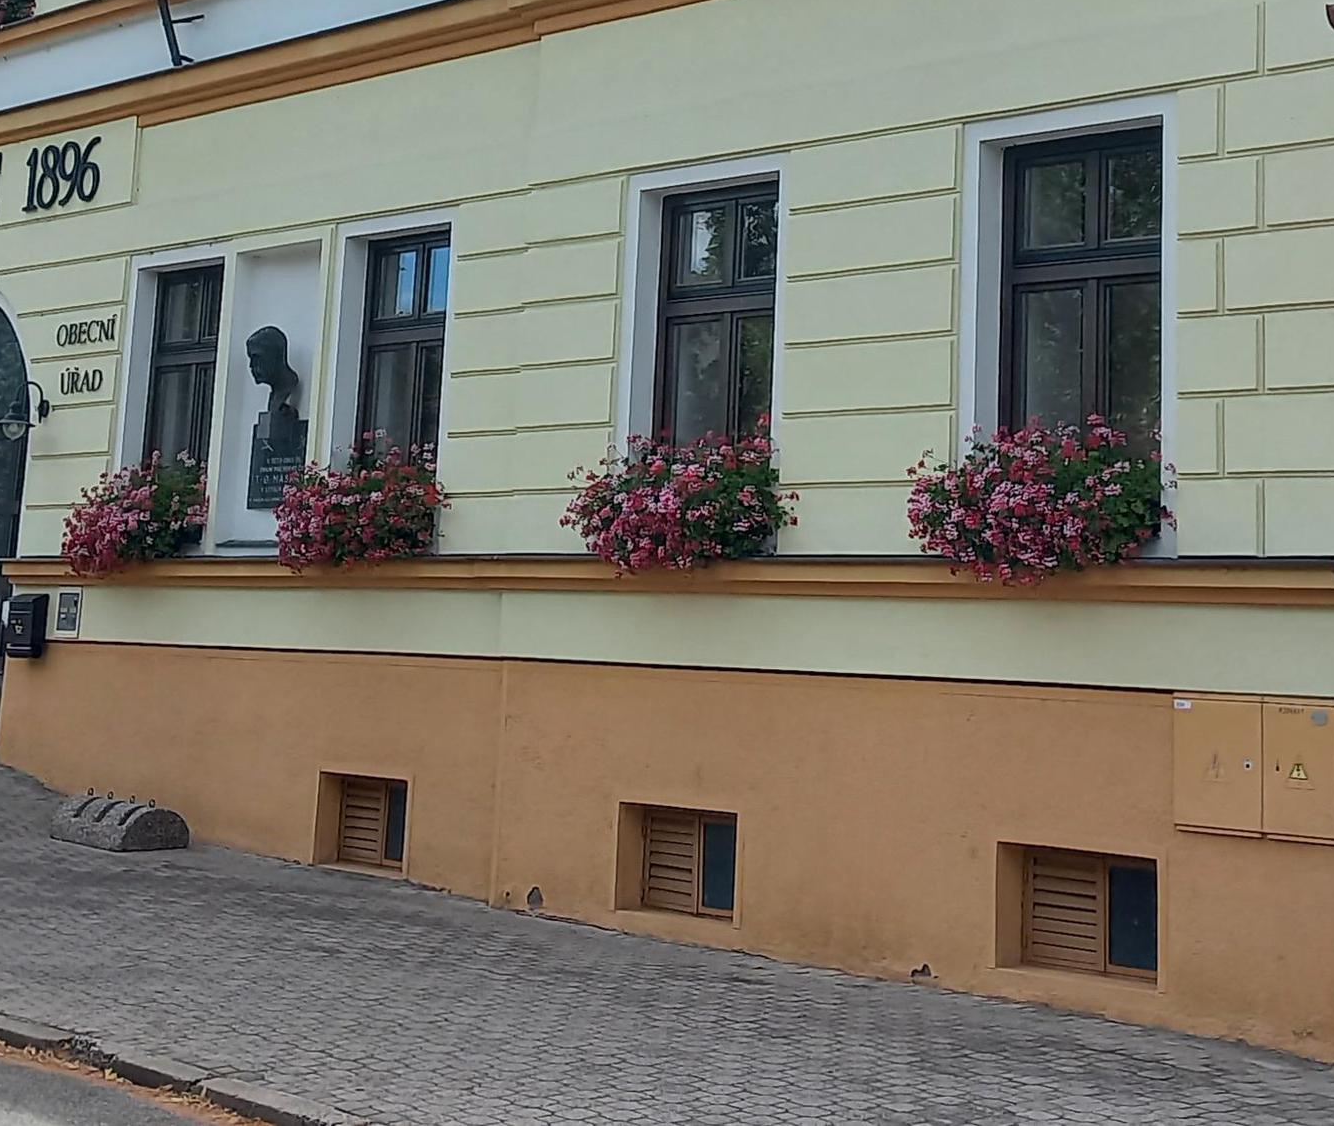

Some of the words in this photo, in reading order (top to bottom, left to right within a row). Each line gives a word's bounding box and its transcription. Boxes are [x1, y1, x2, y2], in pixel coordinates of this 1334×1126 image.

[22, 136, 102, 213] 1896
[56, 313, 118, 347] OBECNÍ
[60, 366, 104, 395] ÚŘAD
